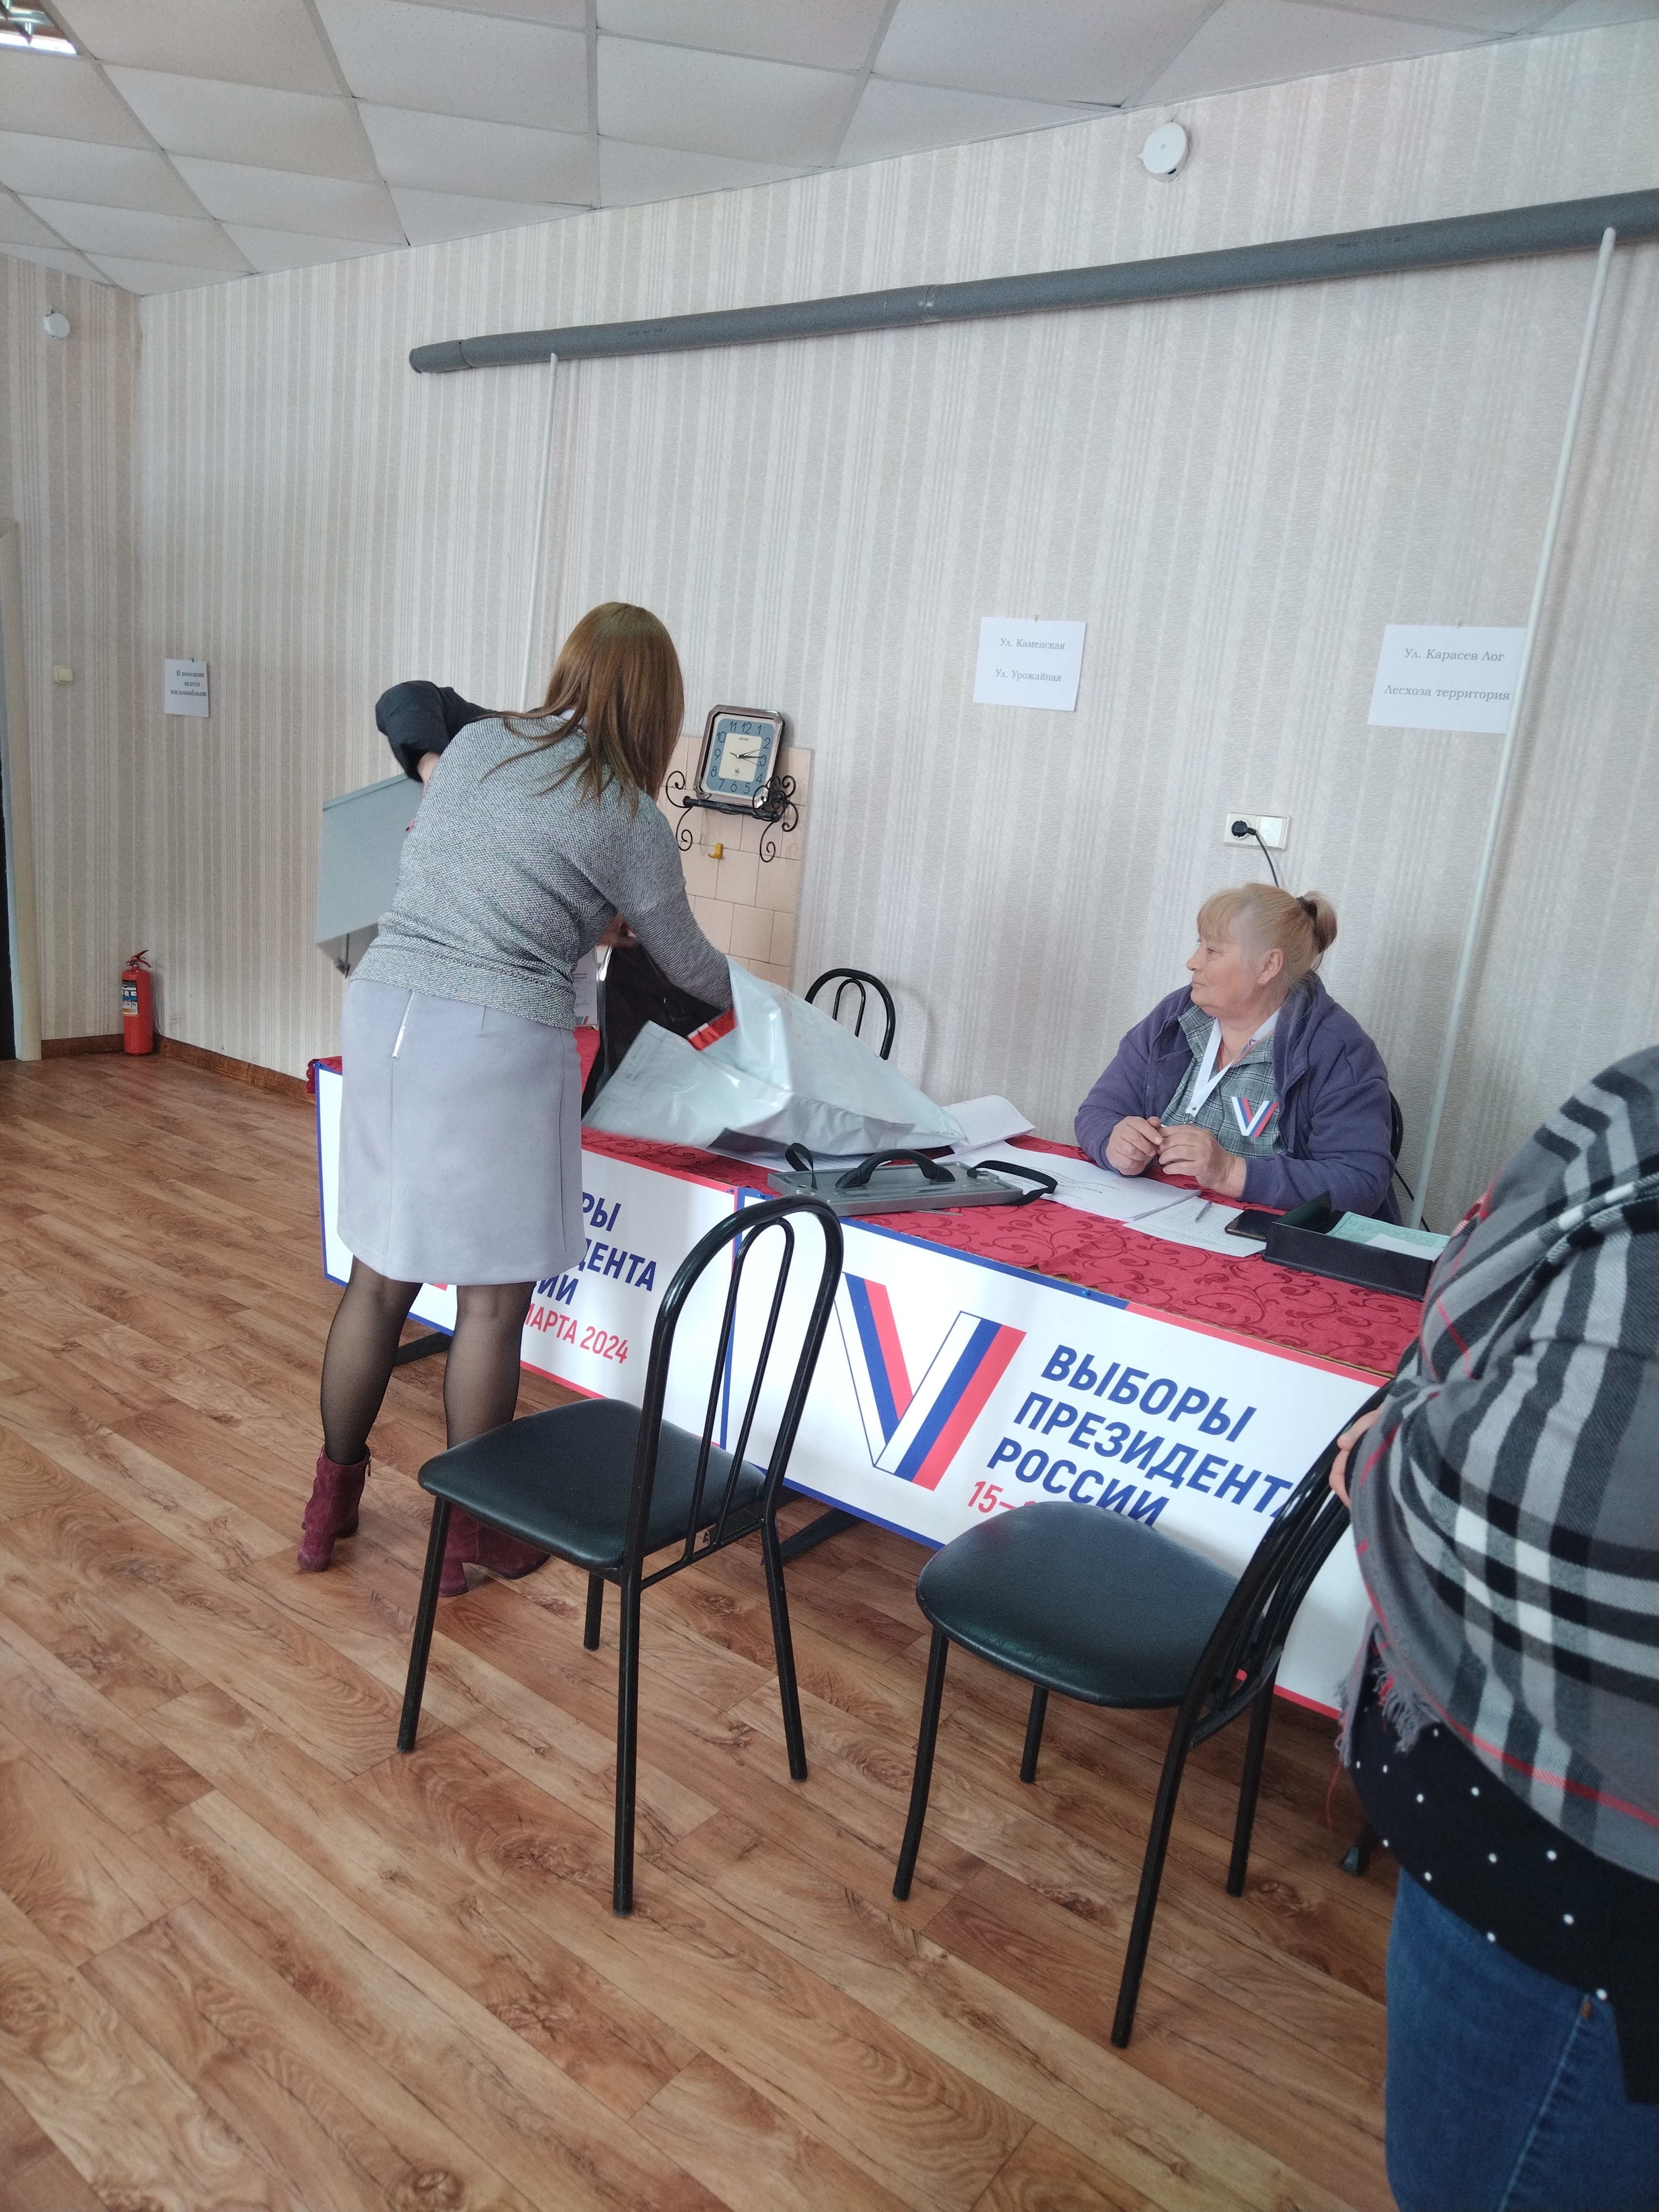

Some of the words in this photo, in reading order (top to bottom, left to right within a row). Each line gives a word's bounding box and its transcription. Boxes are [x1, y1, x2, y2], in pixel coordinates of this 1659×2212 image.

[1000, 637, 1013, 647] Ул.
[1016, 639, 1065, 649] Каменская
[1405, 648, 1421, 659] Ул.
[1426, 649, 1478, 661] Карасев
[1481, 651, 1504, 661] Лог
[996, 669, 1008, 678] Ул.
[1011, 670, 1062, 682] Урожайная
[1384, 685, 1431, 696] Лесхоза
[1435, 689, 1511, 702] территория
[729, 721, 737, 733] 11
[741, 722, 752, 734] 12
[757, 724, 762, 735] 1
[716, 731, 726, 743] 10
[763, 738, 771, 749] 2
[714, 748, 721, 760] 9
[759, 755, 767, 766] 3
[710, 766, 717, 777] 8
[719, 779, 725, 790] 7
[756, 773, 763, 784] 4
[730, 781, 737, 792] 6
[743, 782, 750, 794] 5
[582, 1191, 622, 1232] РЫ
[536, 1274, 579, 1305] ИИ
[579, 1326, 628, 1364] 2024
[1041, 1344, 1257, 1443] ВЫБОРЫ
[987, 1437, 1170, 1527] РОССИИ
[967, 1480, 1037, 1513] 15–
